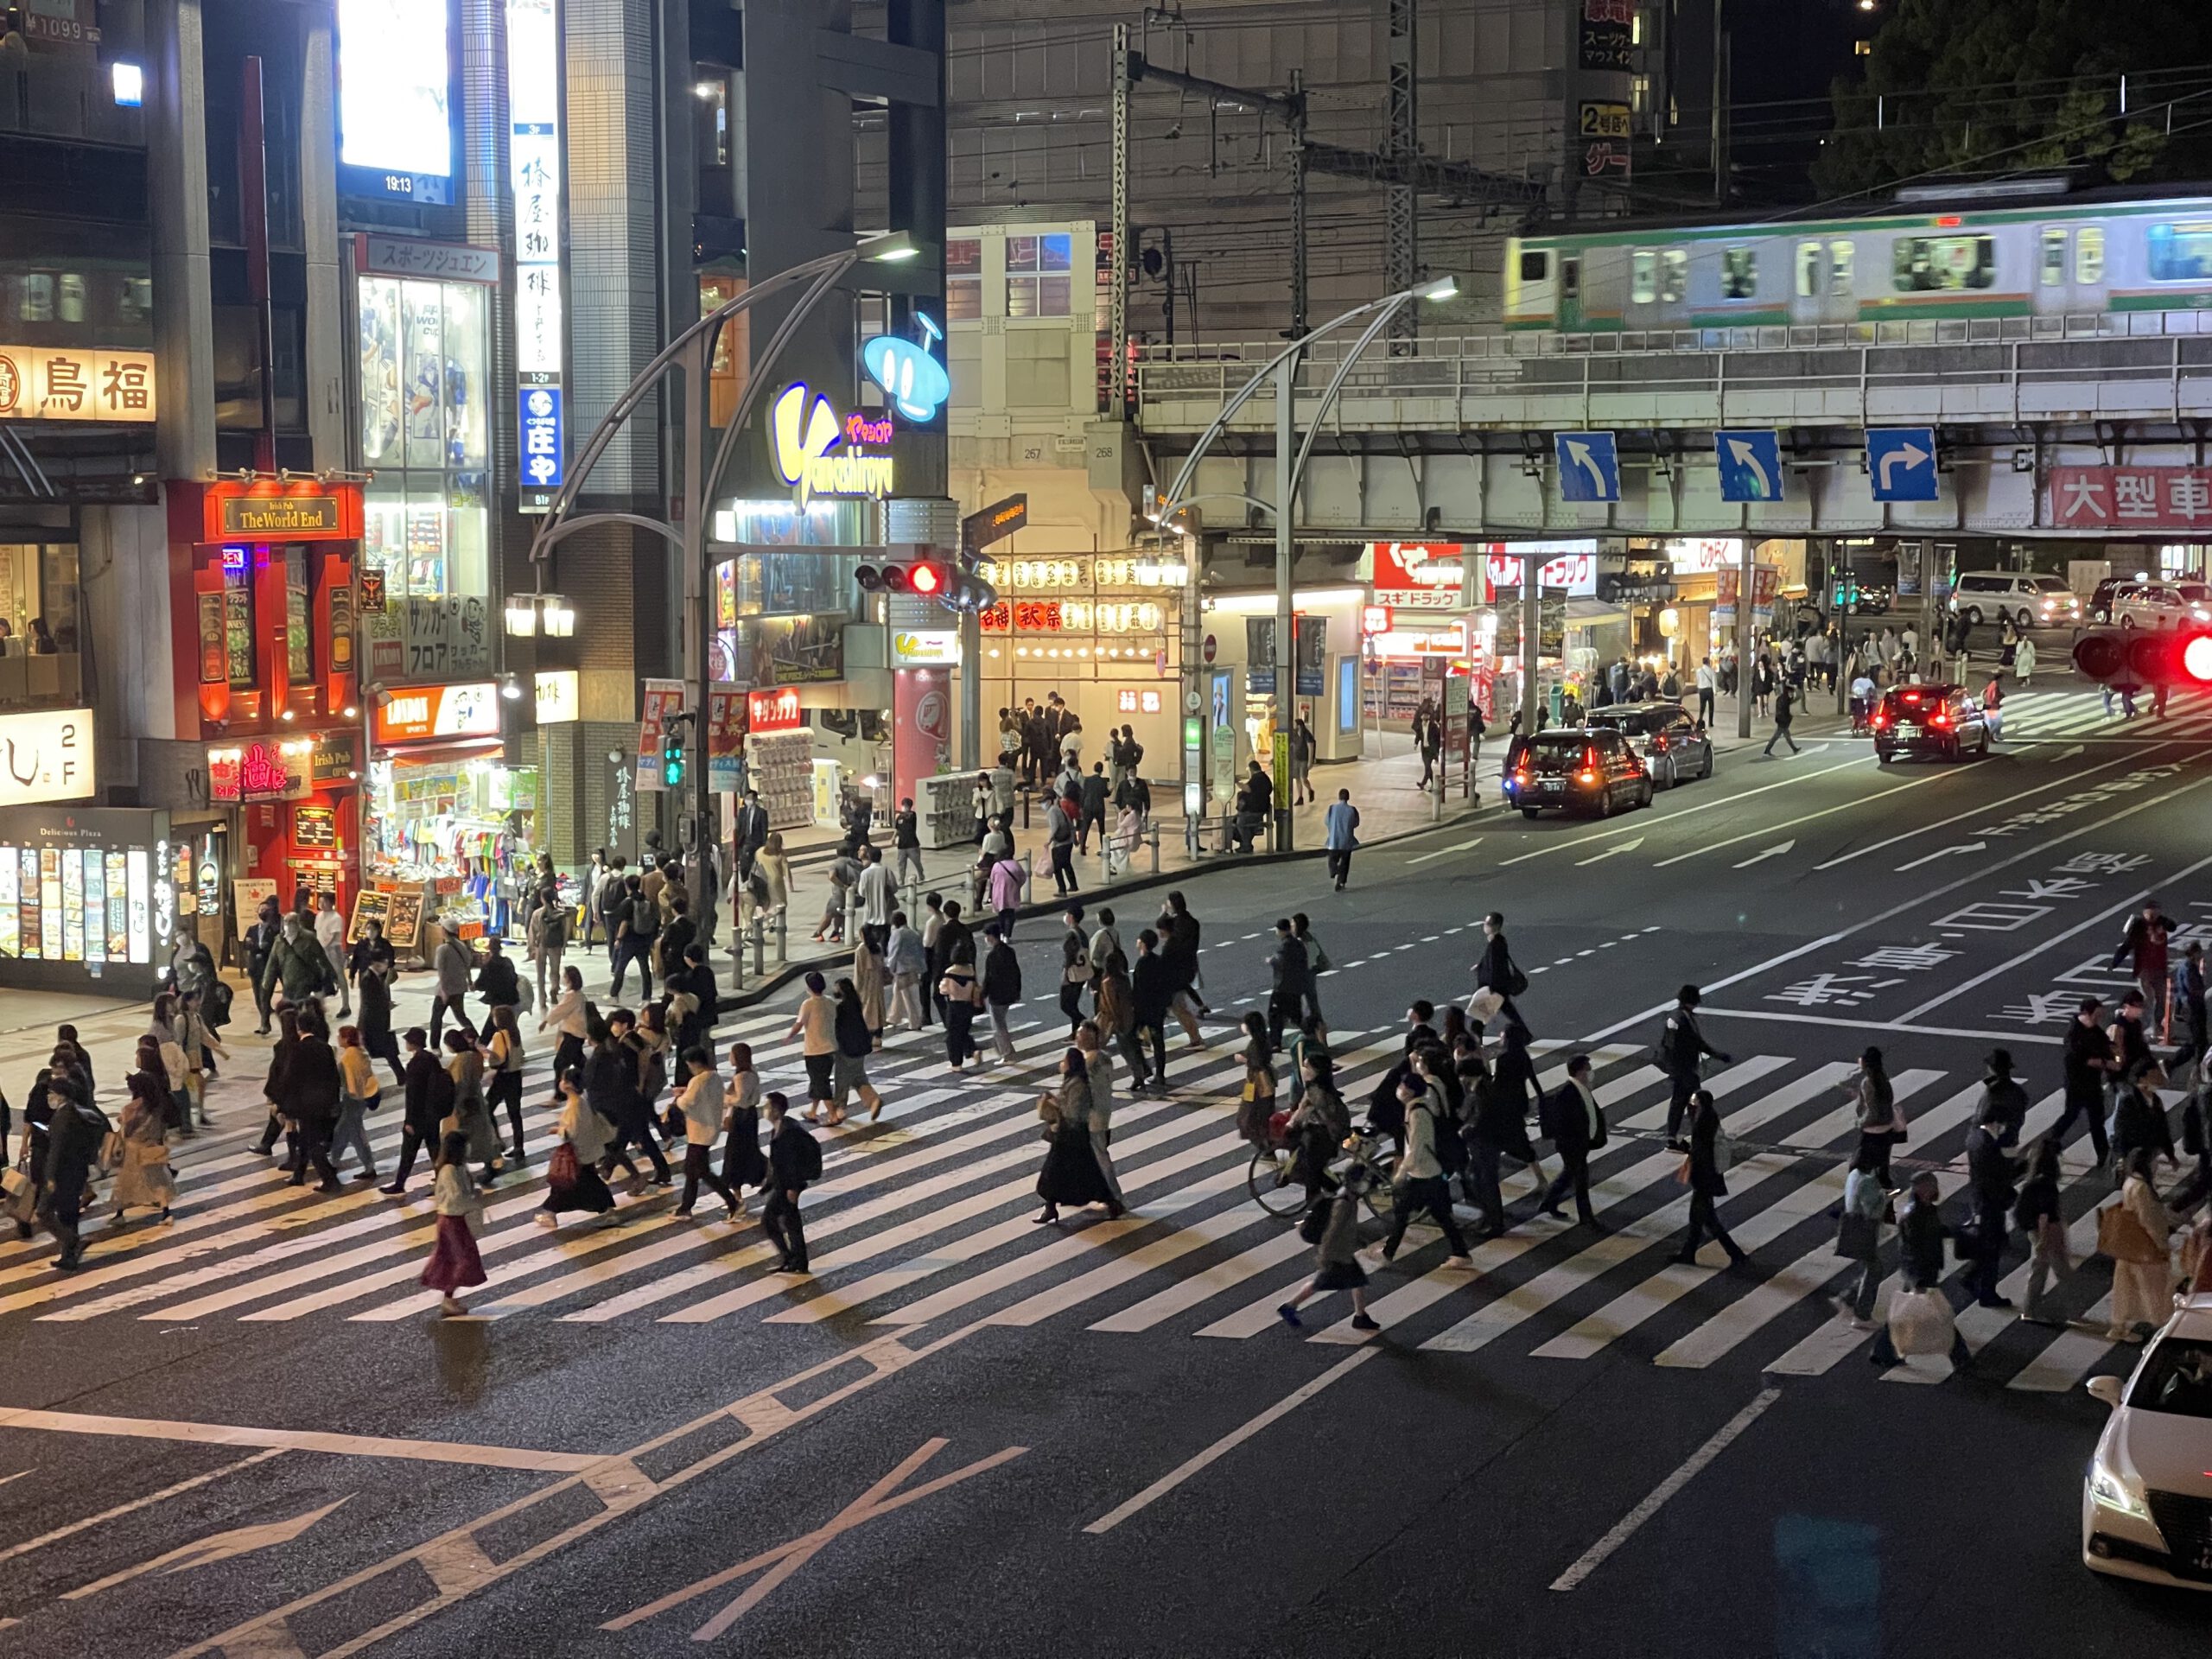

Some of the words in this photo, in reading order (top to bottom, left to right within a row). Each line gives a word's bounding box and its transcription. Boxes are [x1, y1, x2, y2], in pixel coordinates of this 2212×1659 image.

[1584, 107, 1628, 133] 2号店へ
[385, 175, 412, 193] 19:13
[383, 245, 486, 274] スポーツジュエン
[41, 357, 148, 411] 鳥福
[527, 425, 556, 486] 庄や
[1025, 448, 1041, 460] 267
[1096, 448, 1113, 459] 268
[535, 494, 550, 505] B1F
[2063, 474, 2212, 520] 大型車
[240, 512, 263, 528] The
[263, 512, 298, 528] World
[302, 511, 323, 527] End
[224, 553, 241, 563] PEN
[1700, 541, 1729, 568] じゅらく
[1379, 591, 1459, 606] スギドラッグ
[410, 600, 447, 637] サッカー
[410, 643, 448, 672] フロア
[0, 738, 39, 786] し
[315, 753, 334, 766] Irish
[335, 751, 350, 765] Pub
[40, 828, 78, 837] Delicious
[80, 829, 102, 837] Plaza
[132, 899, 145, 933] ねぎし
